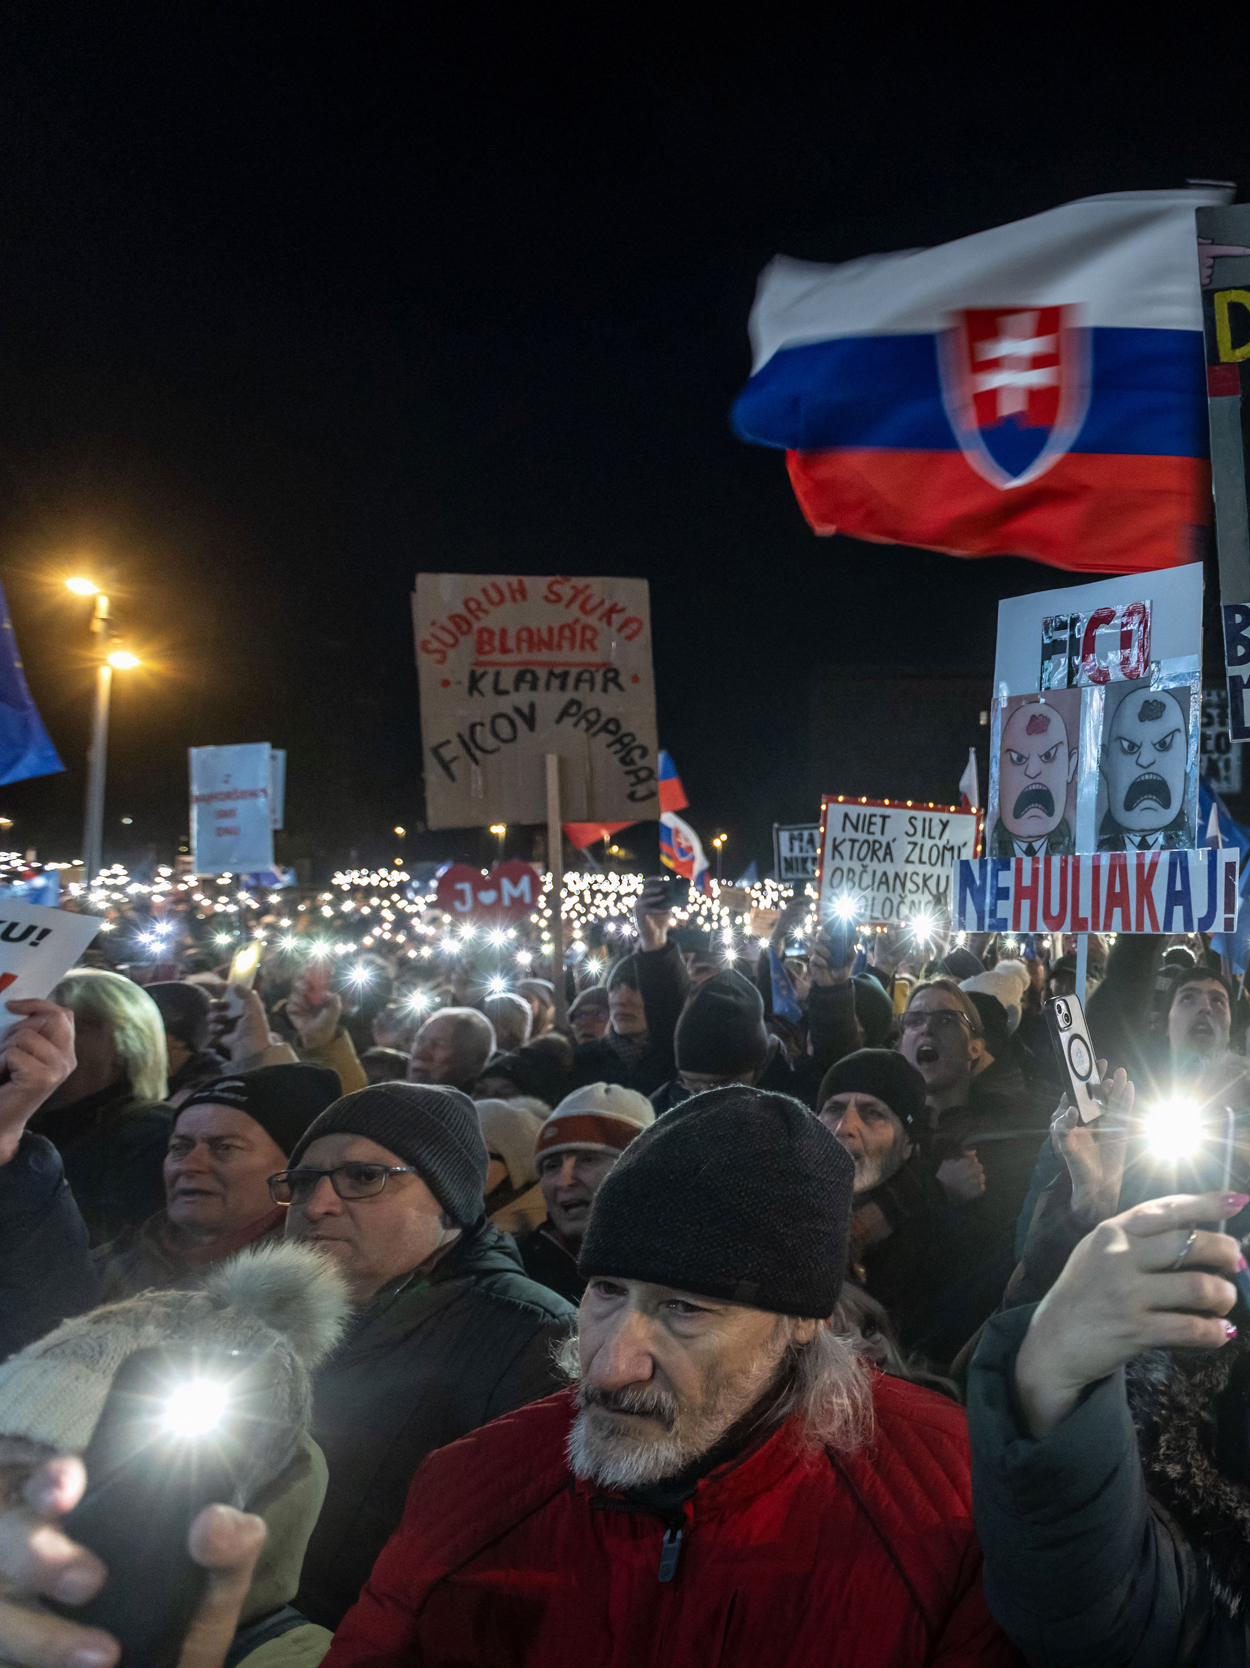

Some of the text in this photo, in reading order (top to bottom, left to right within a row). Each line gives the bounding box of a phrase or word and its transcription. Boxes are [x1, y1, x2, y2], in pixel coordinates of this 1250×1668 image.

[421, 576, 528, 665] SÚDRUH
[475, 618, 599, 656] BLANÁR
[1040, 602, 1150, 691] FICO
[431, 701, 536, 782] FICOV
[842, 812, 950, 845] NIET SILY,
[832, 837, 967, 868] KTORÁ ZLOMÍ
[829, 863, 950, 896] OBČIANSKU
[958, 849, 1238, 932] NEHULIAKAJ!
[0, 920, 52, 947] U!
